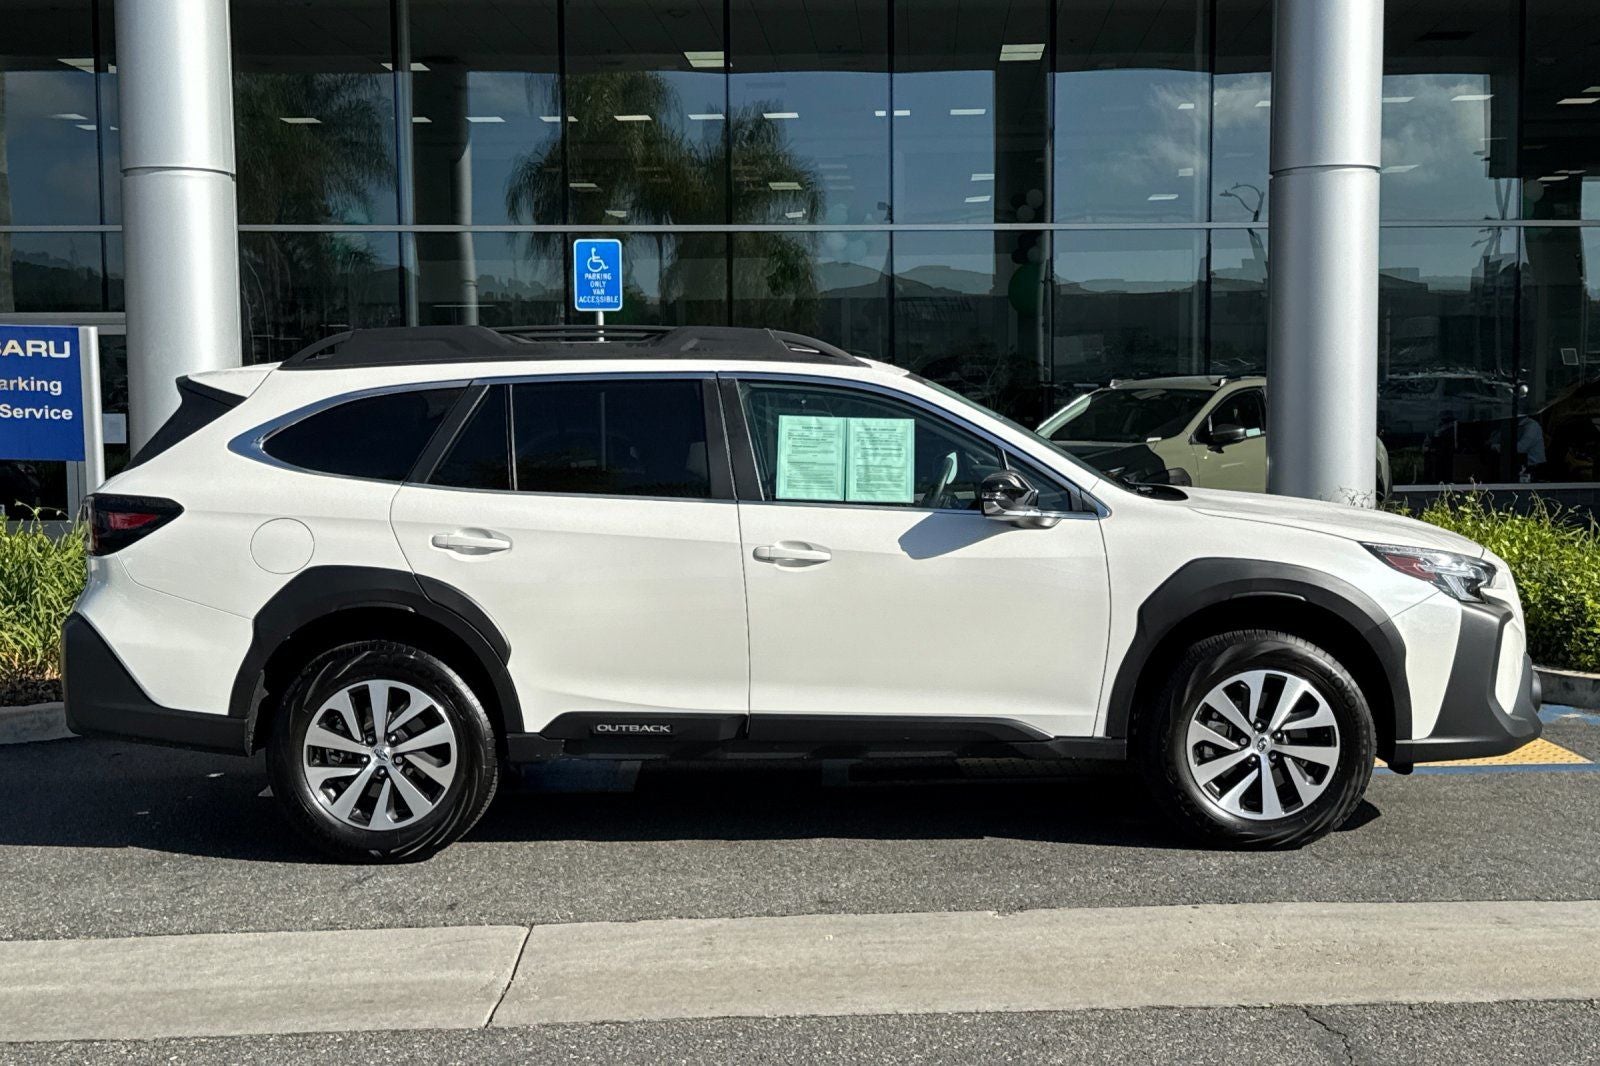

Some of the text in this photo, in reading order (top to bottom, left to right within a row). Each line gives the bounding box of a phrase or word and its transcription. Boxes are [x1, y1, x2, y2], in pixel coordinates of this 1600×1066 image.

[0, 339, 71, 358] ARU
[0, 376, 62, 396] arking
[0, 402, 73, 420] Service
[596, 724, 671, 733] OUTBACK
